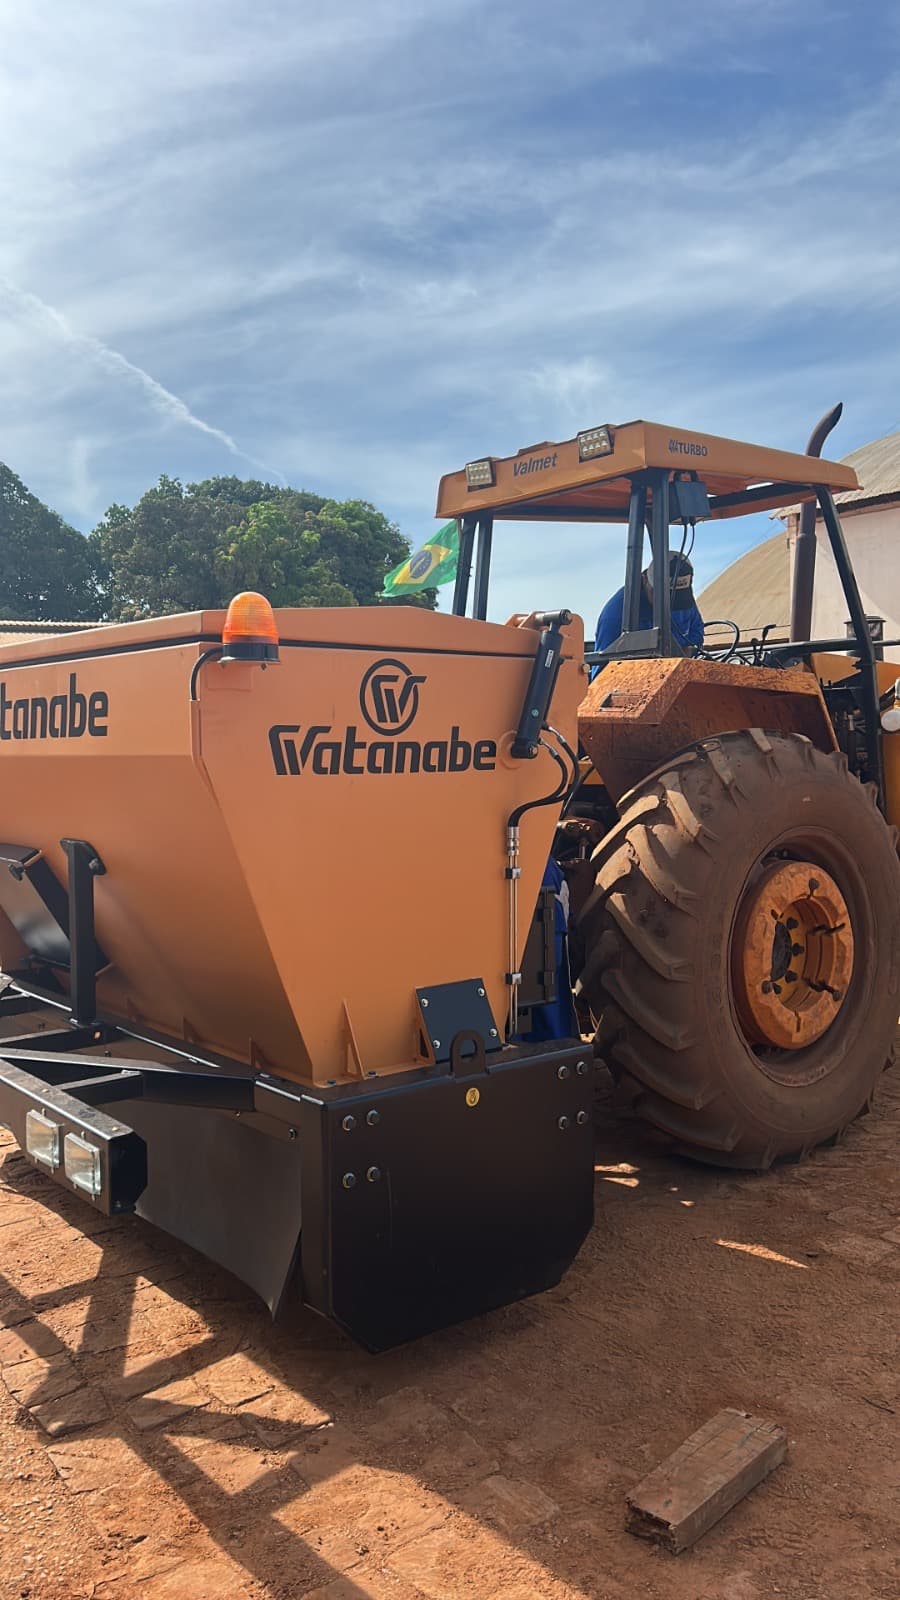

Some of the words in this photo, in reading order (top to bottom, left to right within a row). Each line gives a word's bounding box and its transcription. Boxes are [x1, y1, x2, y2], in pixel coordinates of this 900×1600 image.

[677, 442, 708, 457] TURBO
[513, 452, 558, 476] Valmet
[268, 725, 497, 775] Watanabe
